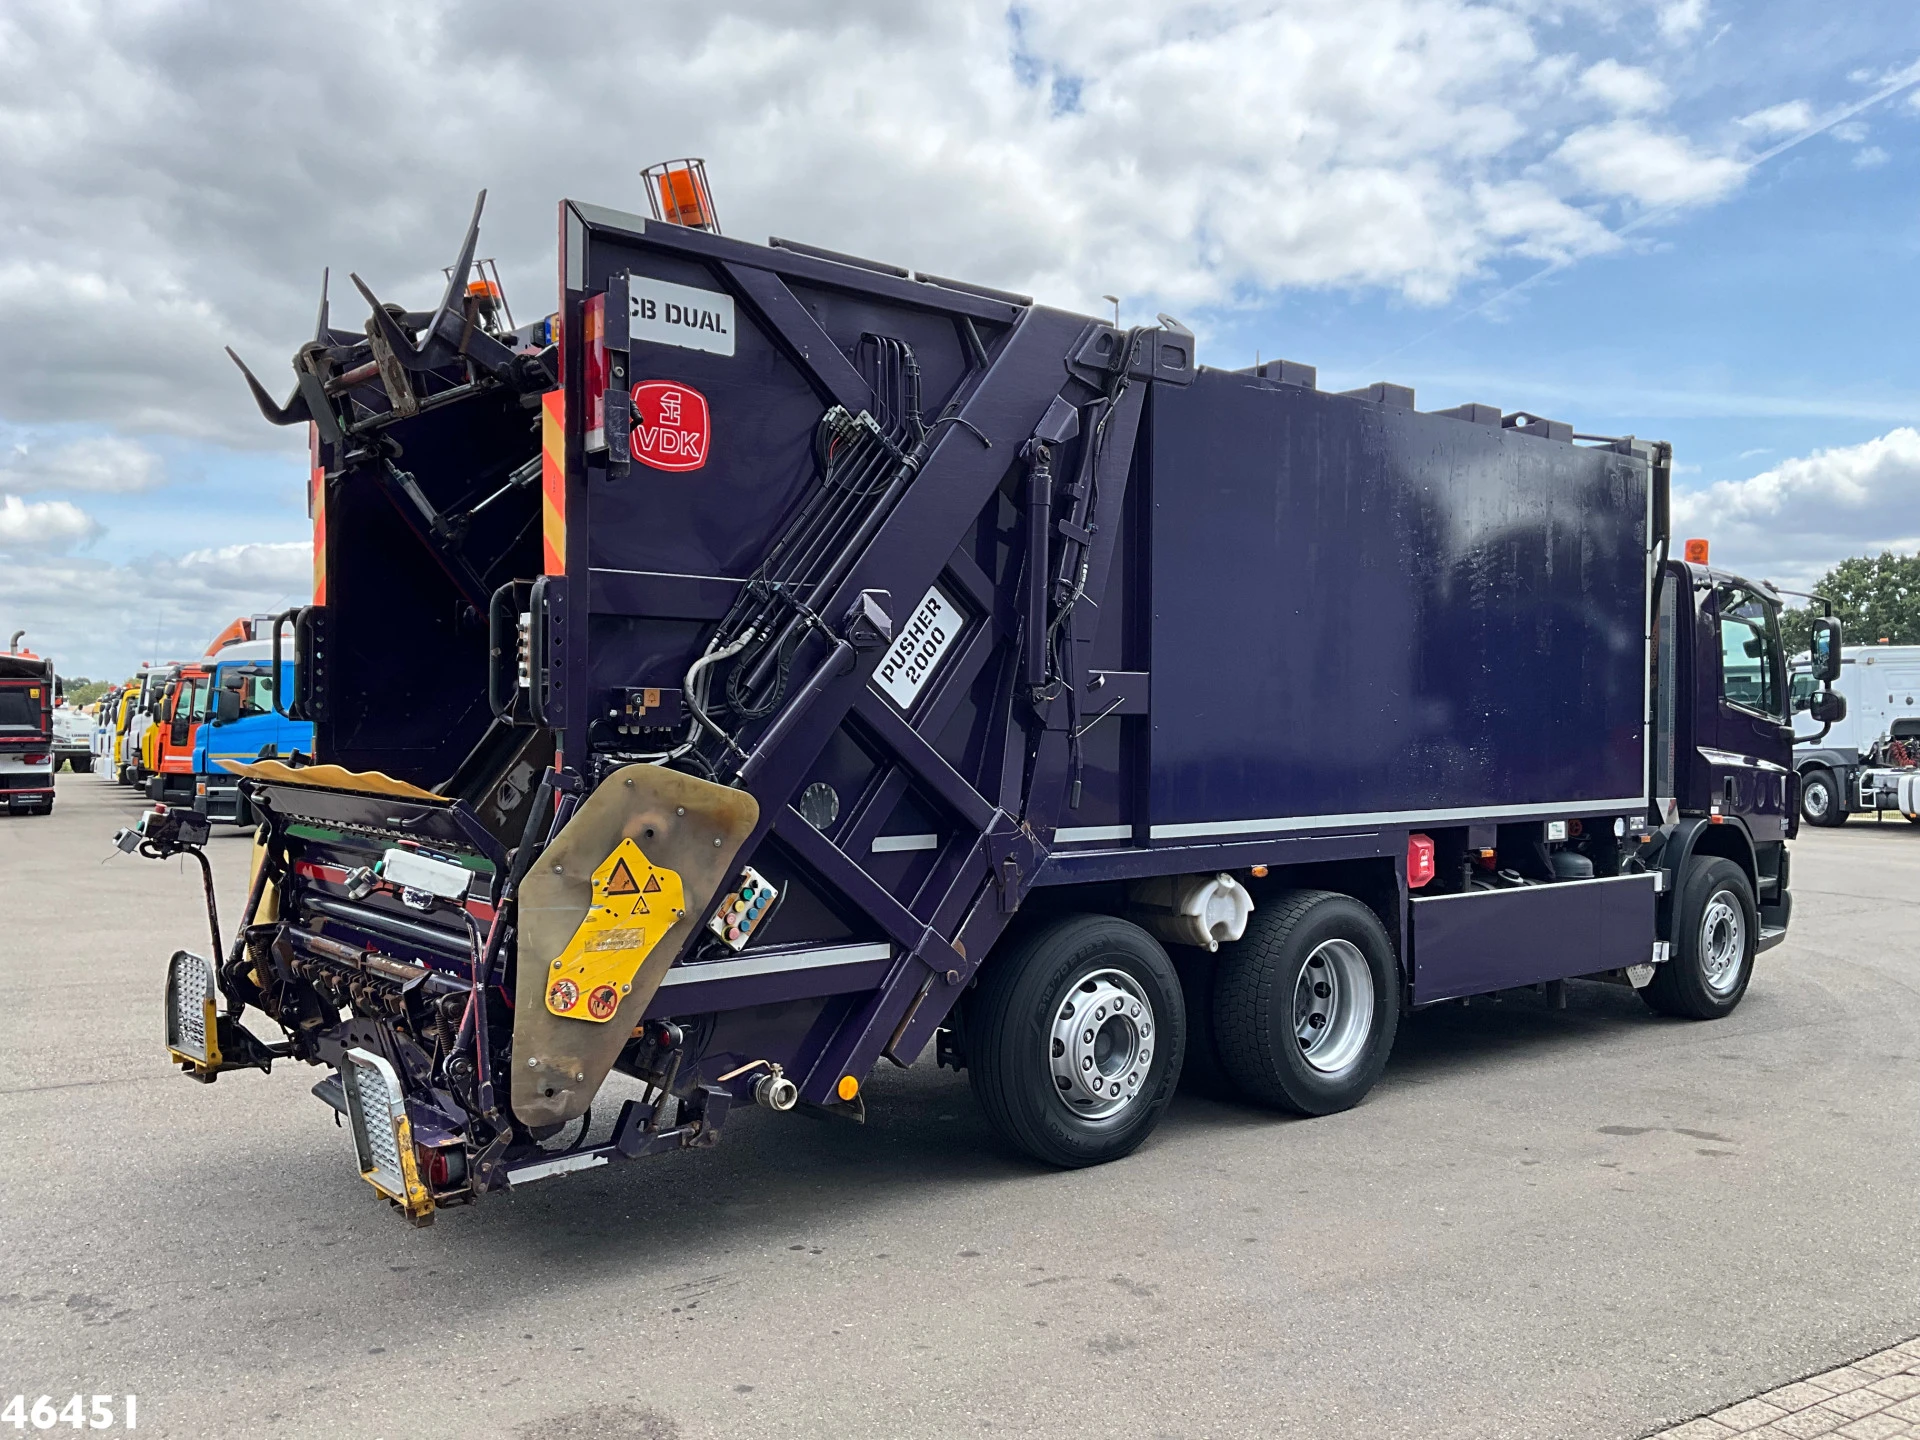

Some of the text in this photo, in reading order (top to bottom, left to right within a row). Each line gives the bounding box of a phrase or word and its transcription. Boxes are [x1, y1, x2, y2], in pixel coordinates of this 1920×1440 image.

[665, 302, 727, 334] DUAL
[637, 424, 700, 458] VDK
[881, 597, 942, 684] PUSHER
[905, 626, 946, 685] 2000
